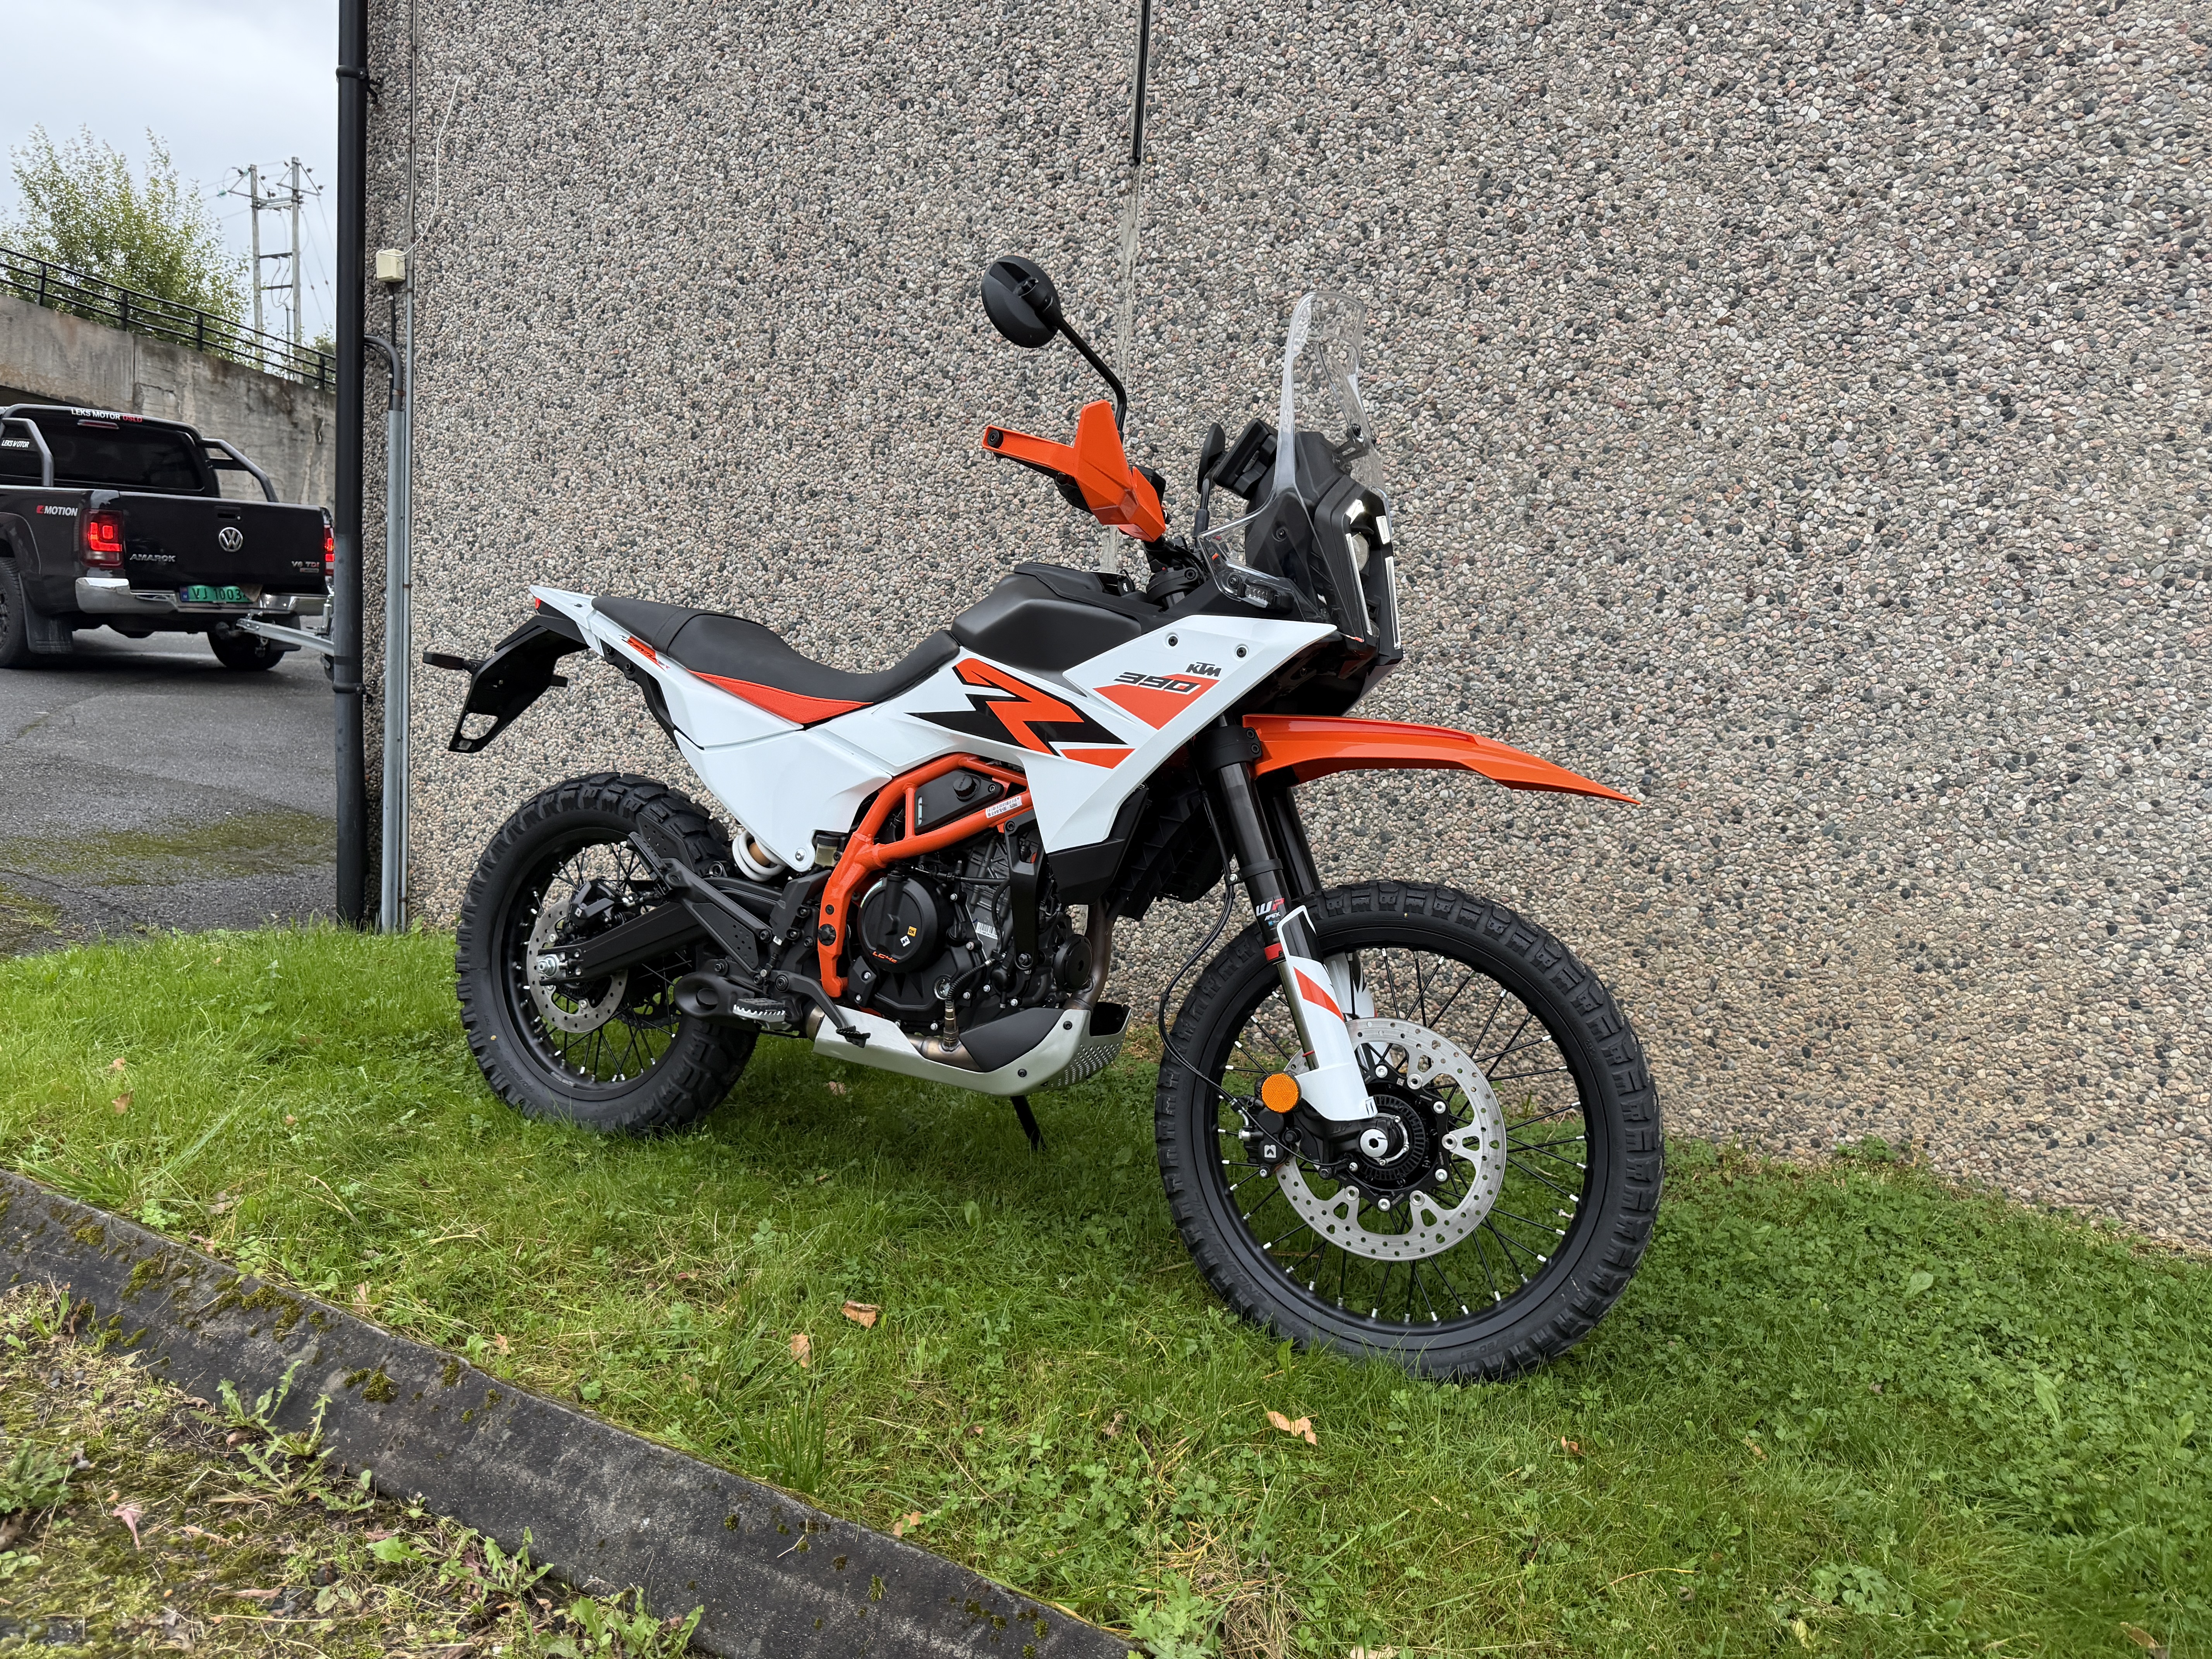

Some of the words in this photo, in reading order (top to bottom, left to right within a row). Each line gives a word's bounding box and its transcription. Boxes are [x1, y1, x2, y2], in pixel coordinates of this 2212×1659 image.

[71, 408, 91, 417] LEKS
[92, 411, 120, 421] MOTOR
[130, 554, 176, 562] AMAROK
[192, 588, 207, 599] VJ
[1185, 662, 1222, 677] KTM
[1113, 672, 1199, 693] 390
[1256, 898, 1285, 917] WP
[1264, 912, 1281, 921] APEX
